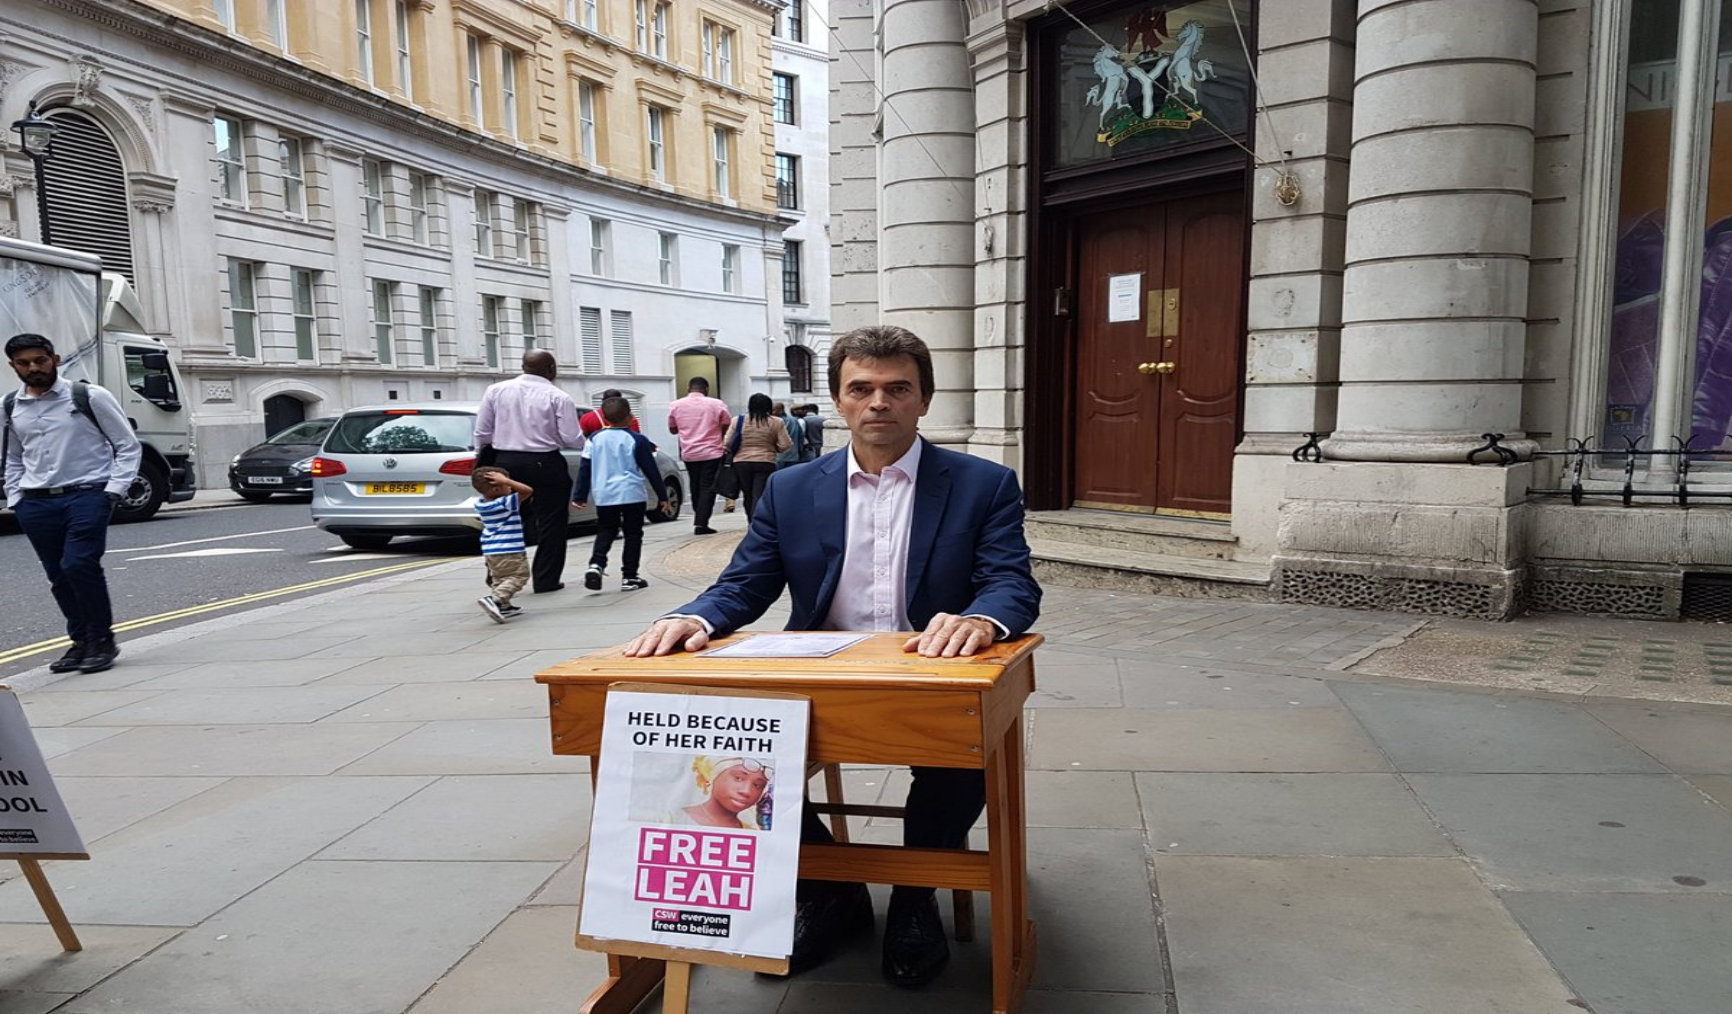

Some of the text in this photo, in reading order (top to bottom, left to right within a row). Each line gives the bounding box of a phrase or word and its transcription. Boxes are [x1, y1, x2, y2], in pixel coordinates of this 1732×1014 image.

[628, 712, 781, 733] HELD BECAUSE
[633, 731, 772, 752] OF HER FAITH
[643, 831, 753, 869] FREE
[637, 868, 750, 908] LEAH
[654, 910, 729, 925] CSW everyone
[653, 921, 728, 936] free to believe
